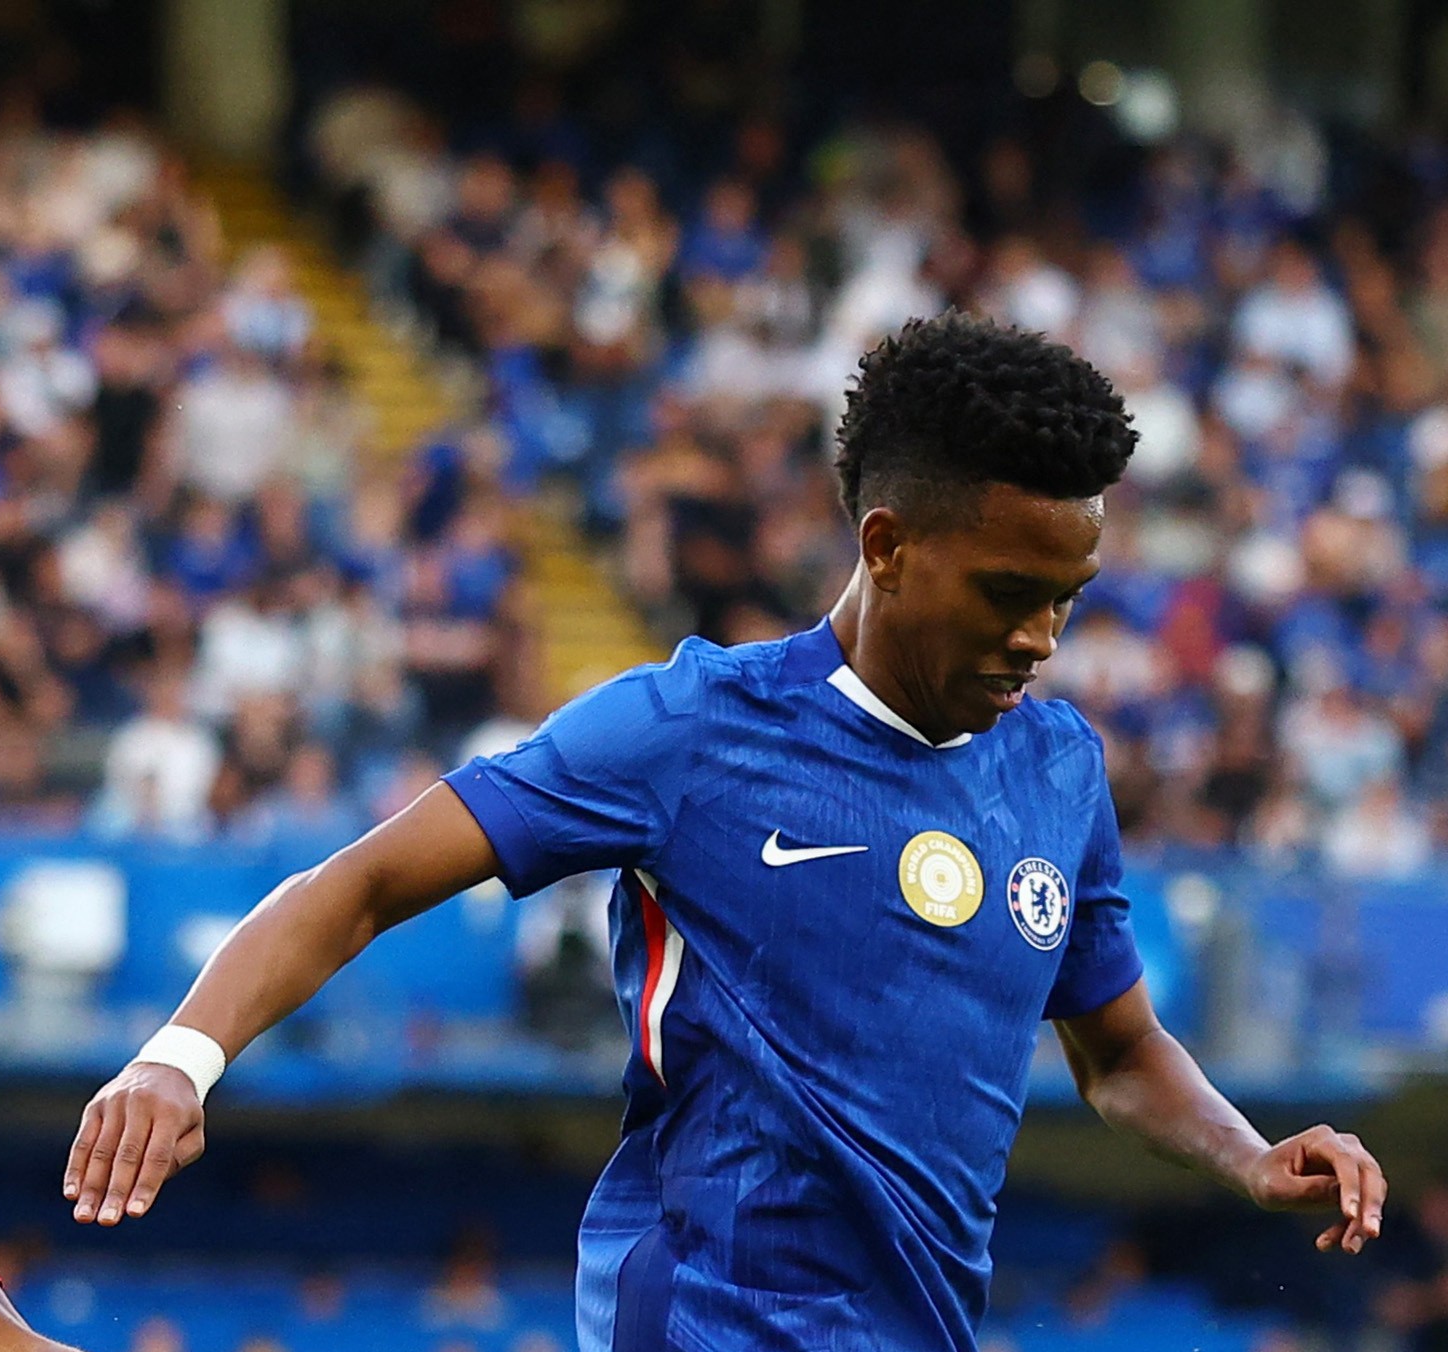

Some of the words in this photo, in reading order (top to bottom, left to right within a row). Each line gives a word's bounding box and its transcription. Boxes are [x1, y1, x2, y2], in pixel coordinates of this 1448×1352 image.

[907, 843, 928, 884] WORLD
[928, 840, 976, 895] CHAMPIONS
[1017, 861, 1062, 886] CHELSEA
[924, 901, 958, 920] FIFA
